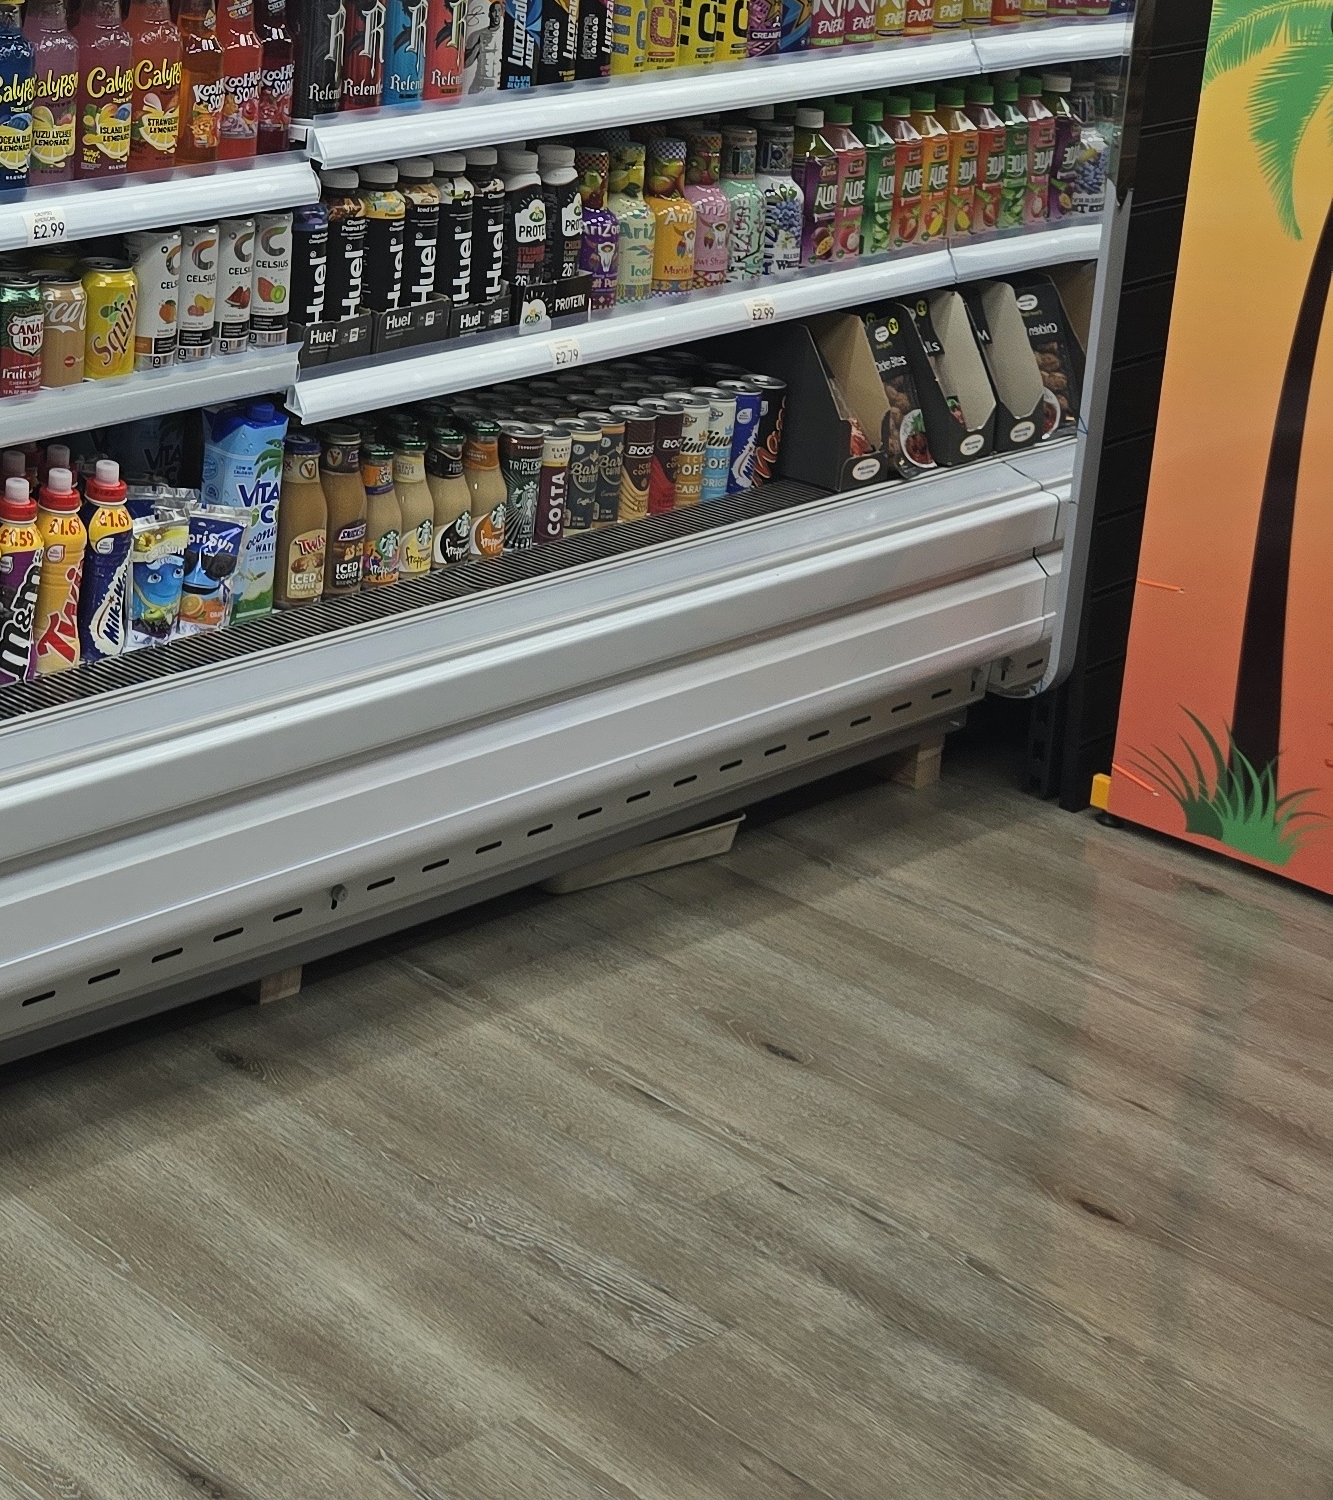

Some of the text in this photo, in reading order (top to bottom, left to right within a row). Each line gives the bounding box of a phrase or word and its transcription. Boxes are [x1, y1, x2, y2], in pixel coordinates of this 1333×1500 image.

[33, 222, 65, 240] £2.99
[256, 259, 288, 269] CELSIUS
[555, 294, 585, 311] PROTEIN
[753, 307, 774, 320] £2.99
[386, 314, 411, 329] Huel
[310, 328, 337, 345] Huel
[555, 349, 578, 364] £2.79
[548, 471, 565, 535] COSTA
[336, 563, 358, 575] ICED
